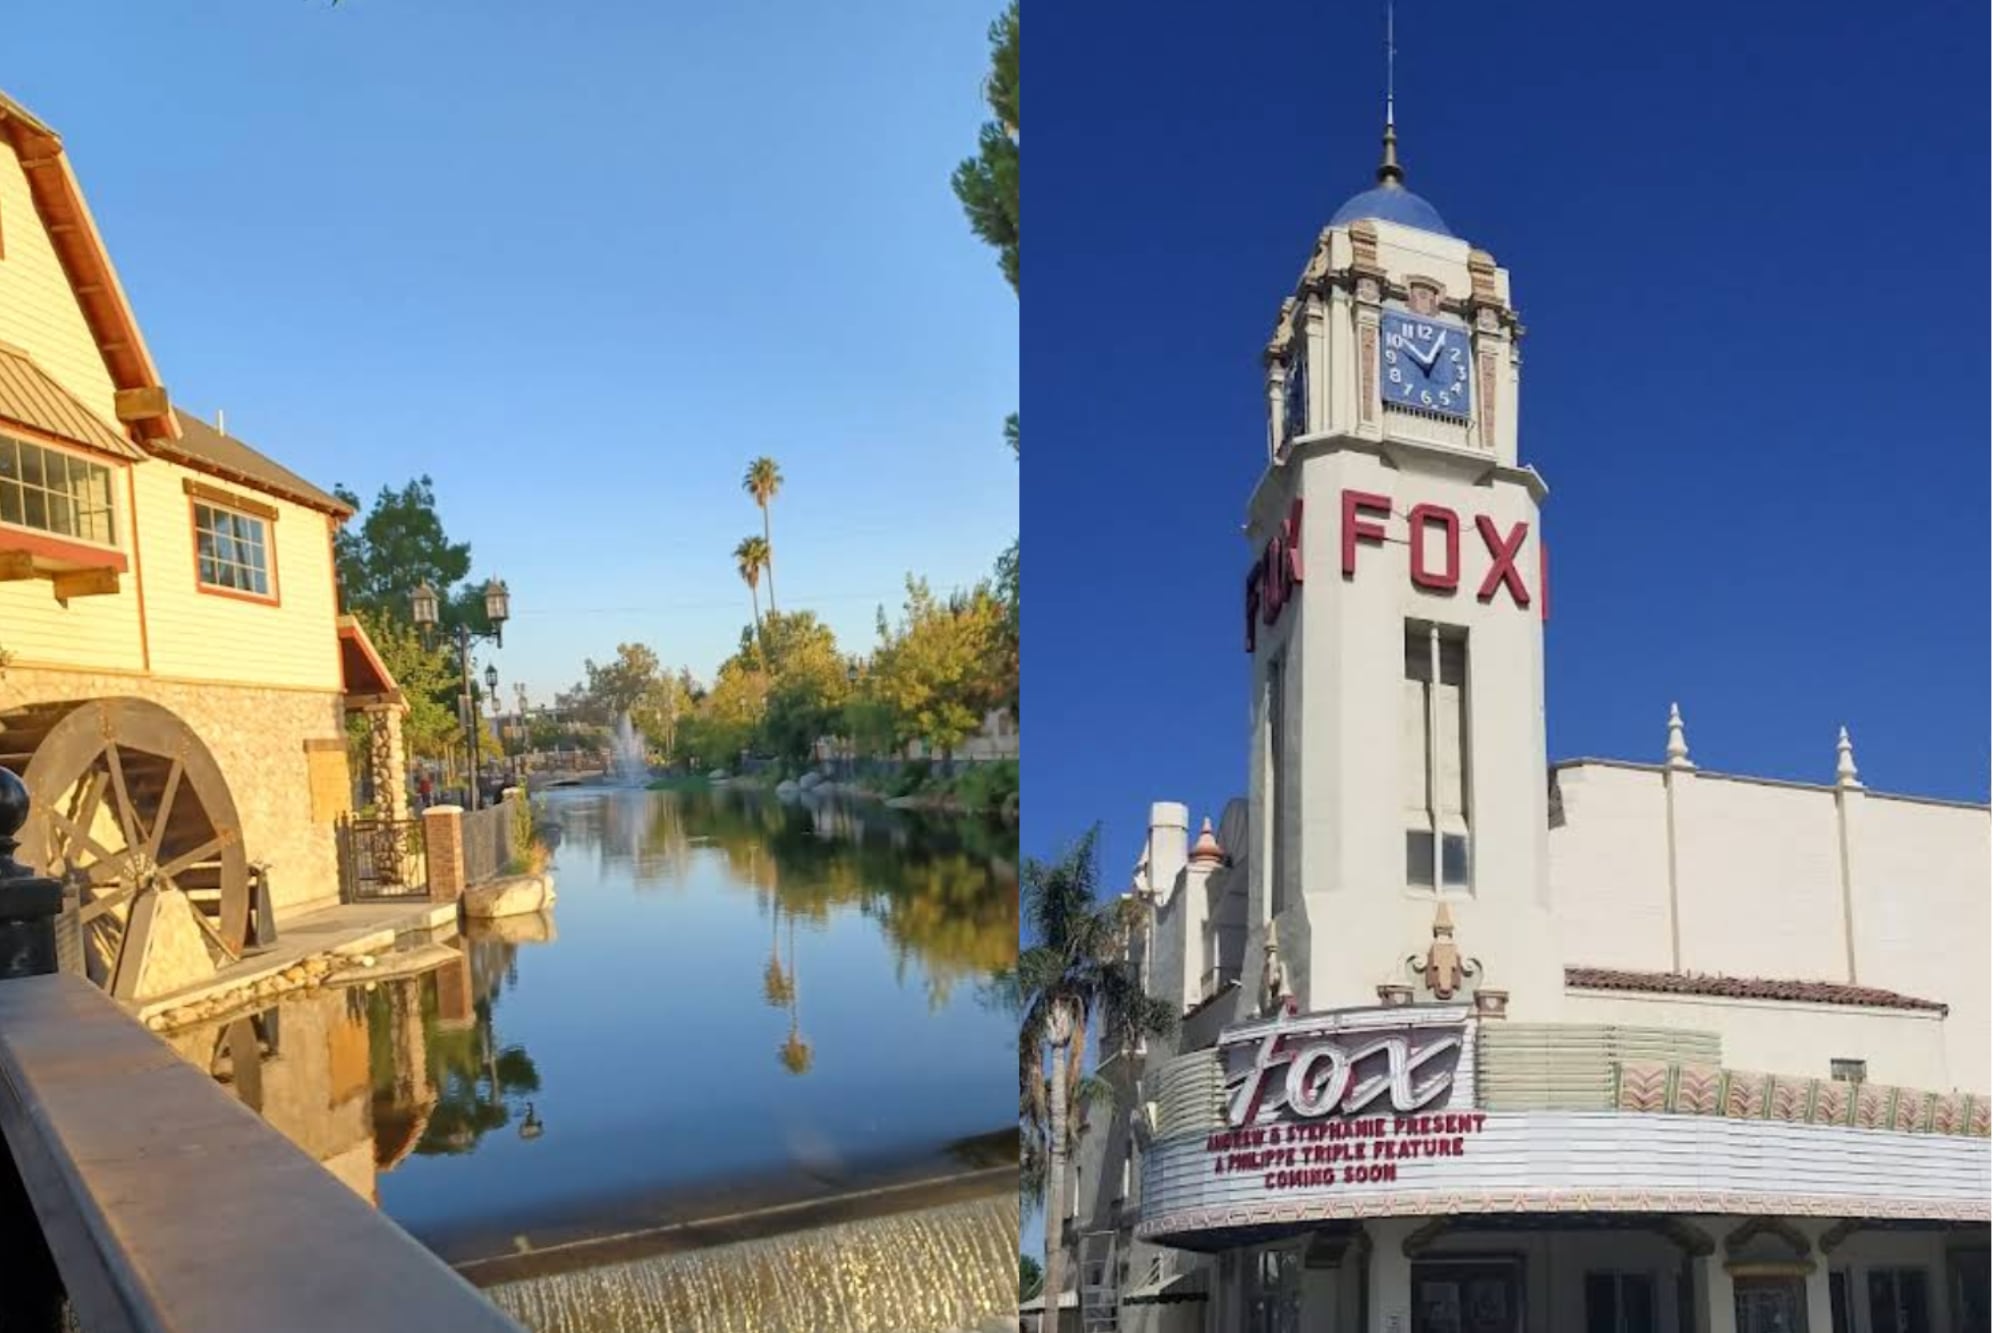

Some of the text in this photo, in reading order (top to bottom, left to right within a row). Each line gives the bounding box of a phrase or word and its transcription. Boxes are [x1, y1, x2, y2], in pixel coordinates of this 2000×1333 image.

[1402, 323, 1414, 339] 11
[1418, 324, 1433, 341] 12
[1385, 332, 1402, 349] 10
[1384, 350, 1397, 364] 9
[1450, 348, 1461, 362] 2
[1389, 368, 1401, 383] 8
[1456, 365, 1467, 381] 3
[1403, 383, 1414, 396] 7
[1450, 382, 1462, 395] 4
[1420, 390, 1432, 405] 6
[1438, 390, 1450, 406] 5
[1341, 488, 1531, 605] FOX
[1285, 1117, 1387, 1143] STEPHANIE
[1393, 1113, 1487, 1136] PRESENT
[1214, 1137, 1464, 1175] A PHILIPPE TRIPLE FEATURE
[1264, 1163, 1396, 1190] COMING SOON
